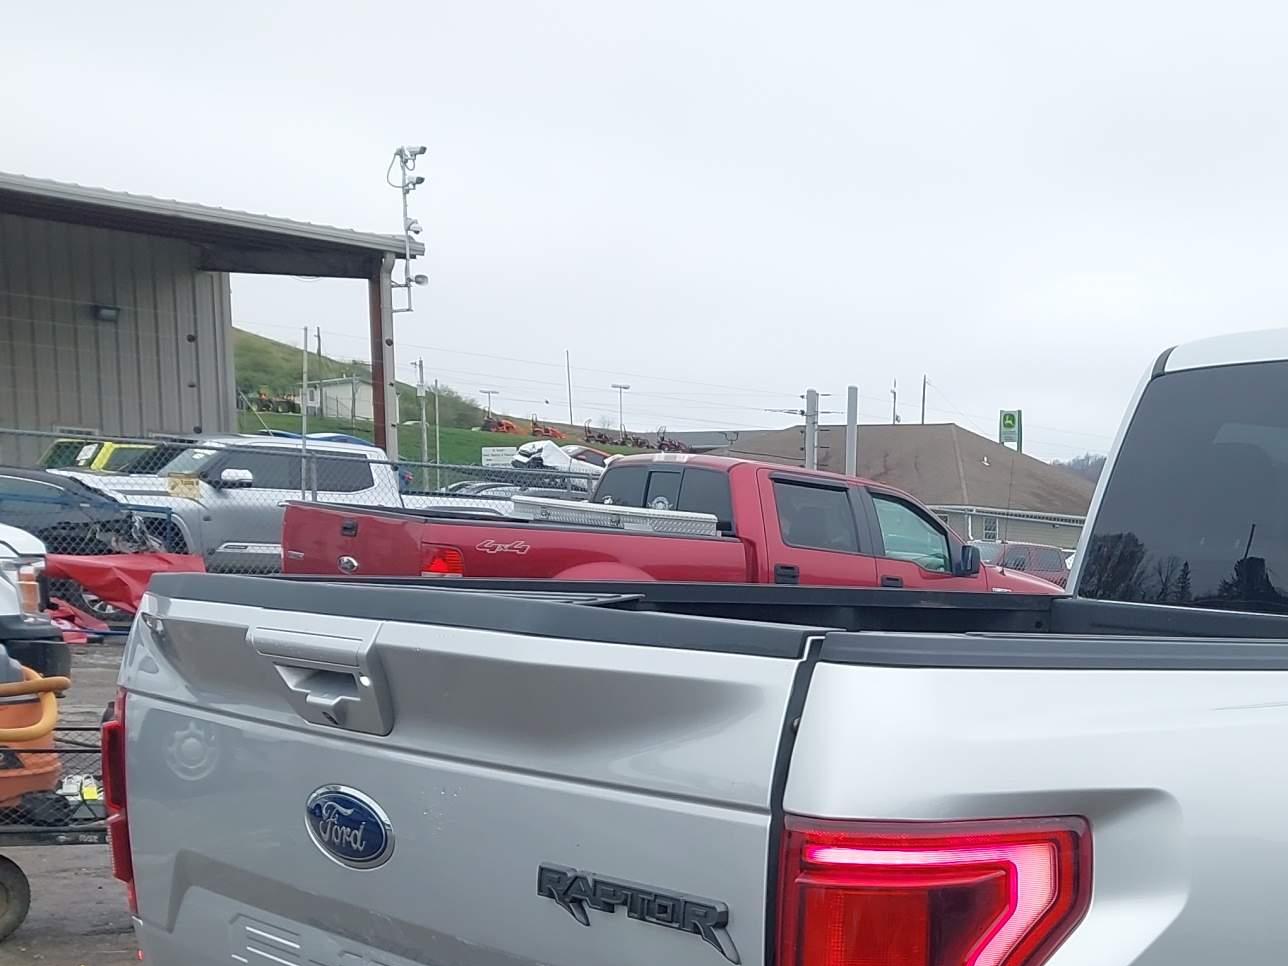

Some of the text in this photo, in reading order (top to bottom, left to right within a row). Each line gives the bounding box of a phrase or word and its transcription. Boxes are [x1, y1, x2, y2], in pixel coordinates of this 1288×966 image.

[475, 539, 531, 555] 4x4
[319, 801, 367, 852] Ford
[537, 862, 742, 966] RAPTOR
